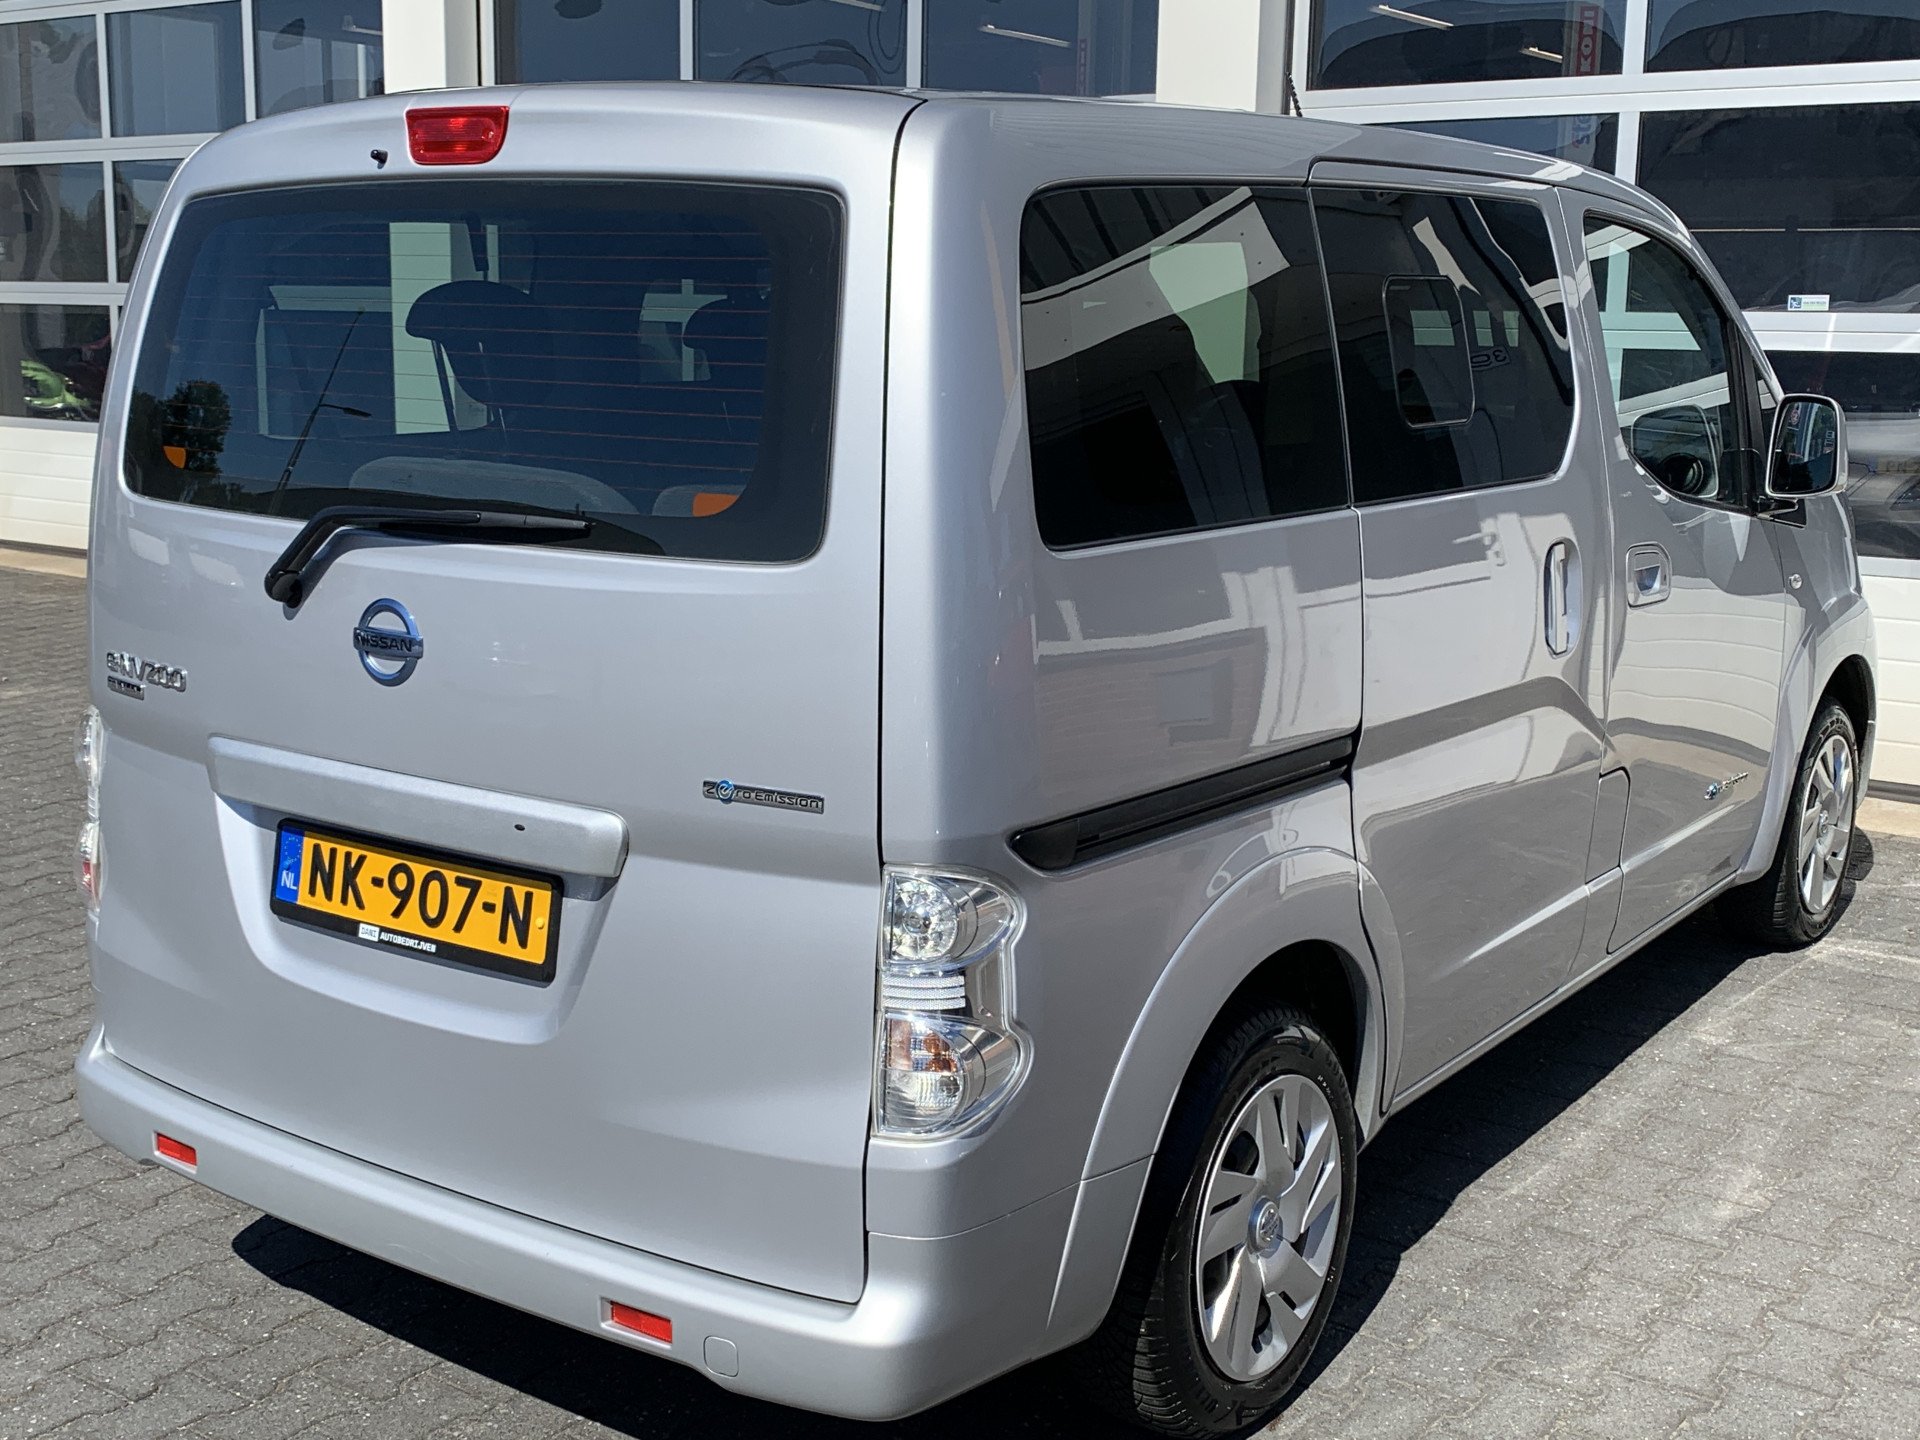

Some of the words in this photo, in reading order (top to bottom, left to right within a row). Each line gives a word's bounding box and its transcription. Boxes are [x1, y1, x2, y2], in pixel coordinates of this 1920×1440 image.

[1580, 10, 1596, 73] KONI
[356, 629, 413, 652] NISSAN
[280, 870, 298, 890] NL
[308, 842, 534, 950] NK-907-N
[360, 926, 378, 938] DANI
[379, 931, 437, 953] AUTOBEDRIJVEN
